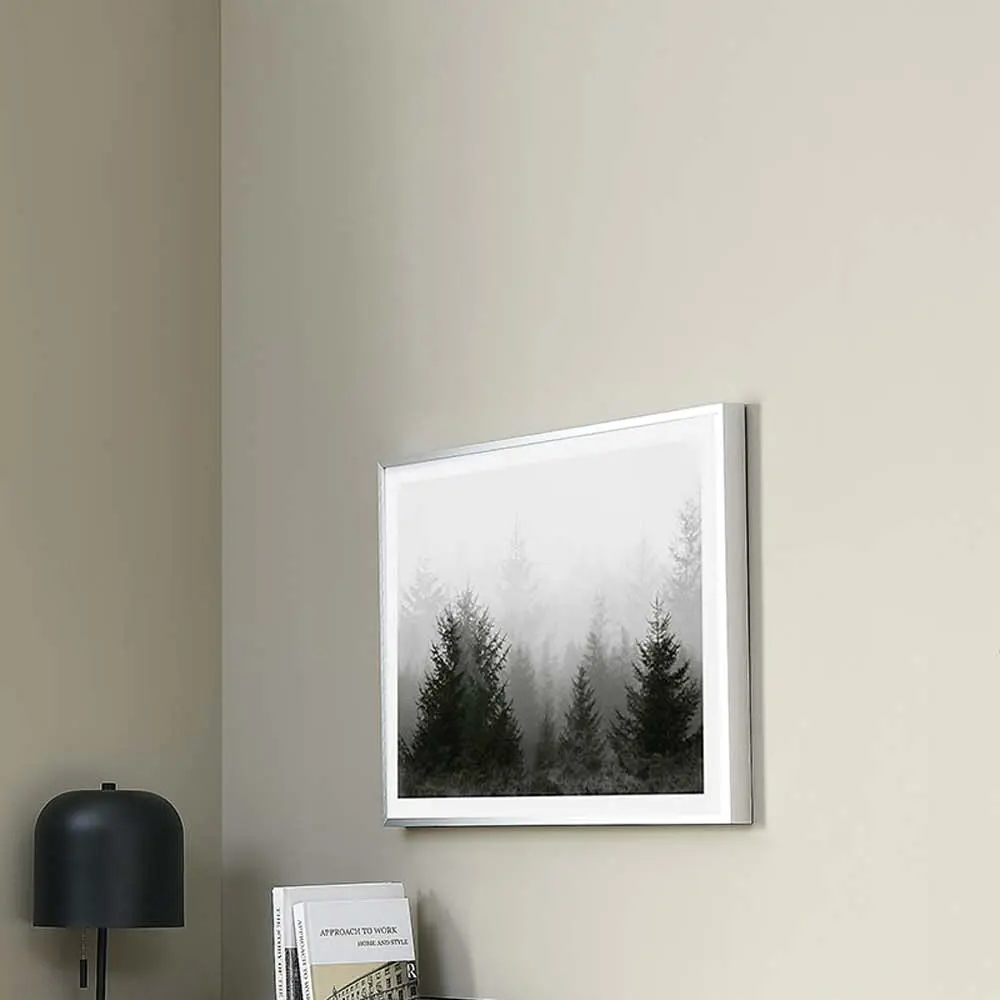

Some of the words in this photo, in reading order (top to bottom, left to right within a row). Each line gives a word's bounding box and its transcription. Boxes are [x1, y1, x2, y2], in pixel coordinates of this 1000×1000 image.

[297, 919, 306, 965] APPROACH
[302, 968, 308, 980] TO
[319, 927, 361, 937] APPROACH
[361, 927, 373, 935] TO
[373, 926, 398, 935] WORK
